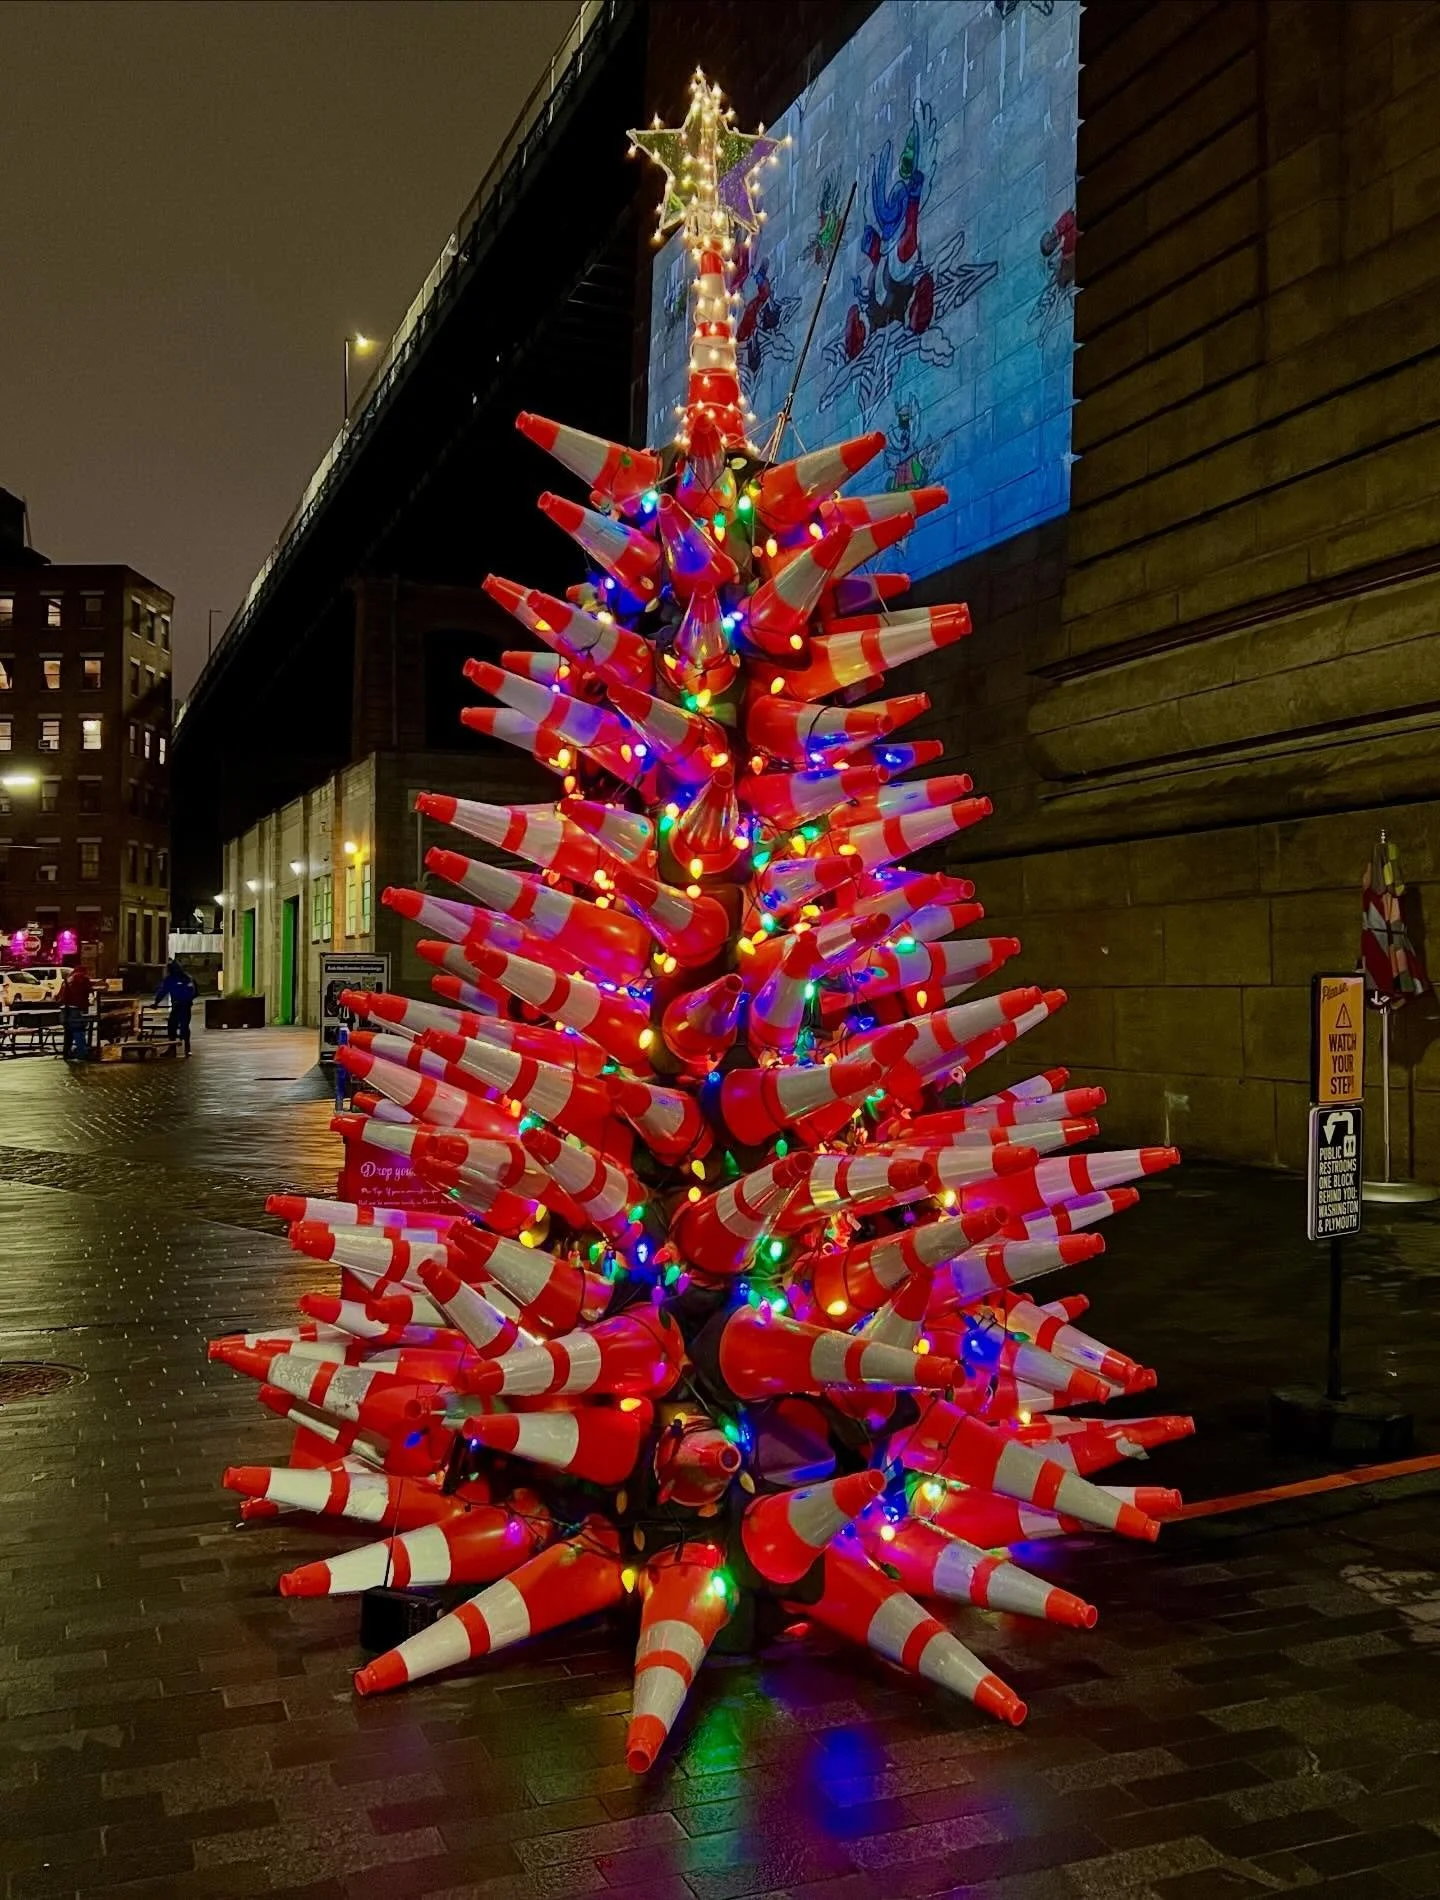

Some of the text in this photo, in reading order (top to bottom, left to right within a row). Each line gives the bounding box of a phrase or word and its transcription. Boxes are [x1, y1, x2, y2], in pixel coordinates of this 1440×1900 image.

[24, 940, 39, 948] STOP
[1328, 1032, 1357, 1052] WATCH
[1331, 1054, 1354, 1073] YOUR
[1319, 1146, 1342, 1160] PUBLIC
[360, 1161, 393, 1182] Drop
[1319, 1158, 1357, 1175] RESTROOMS
[1318, 1173, 1354, 1189] ONE BLOCK
[1318, 1188, 1342, 1204] BEHIND
[1318, 1200, 1359, 1218] WASHINGTON
[1317, 1214, 1357, 1233] & PLYMOUTH
